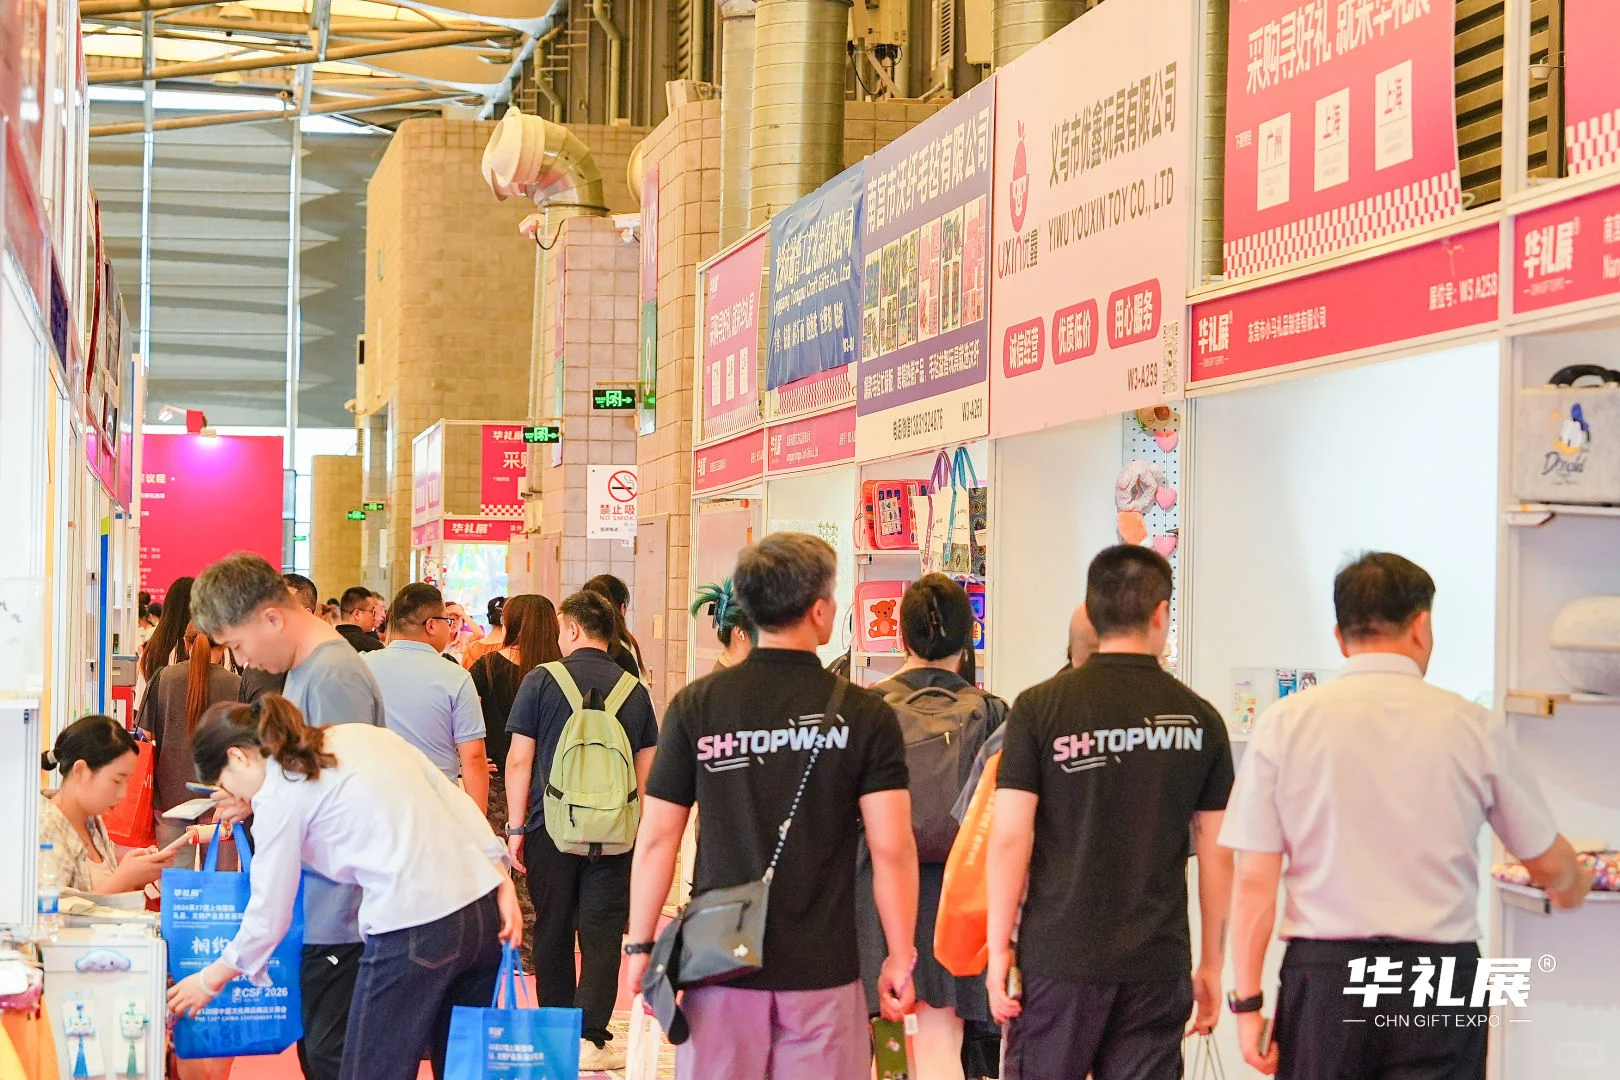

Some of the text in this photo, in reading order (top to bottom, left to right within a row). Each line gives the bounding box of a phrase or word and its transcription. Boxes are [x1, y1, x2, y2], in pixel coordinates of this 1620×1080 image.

[1246, 0, 1430, 94] 采购寻好礼 就来华
[1049, 60, 1176, 190] 义乌市优鑫玩具有限公司
[866, 105, 990, 236] 南宫市沃纤毛毡有限公司
[1048, 166, 1174, 252] YIWU YOUXIN TOY CO., LTD
[1058, 308, 1091, 356] 优质低价
[1114, 288, 1153, 340] 用心服务
[1198, 314, 1229, 354] 华礼展
[1009, 327, 1039, 370] 诚信经营
[1127, 363, 1159, 392] W3-A259
[492, 430, 523, 440] 华礼展
[141, 473, 166, 484] 议程
[451, 523, 488, 535] 华礼展
[242, 986, 289, 998] CSF 2026
